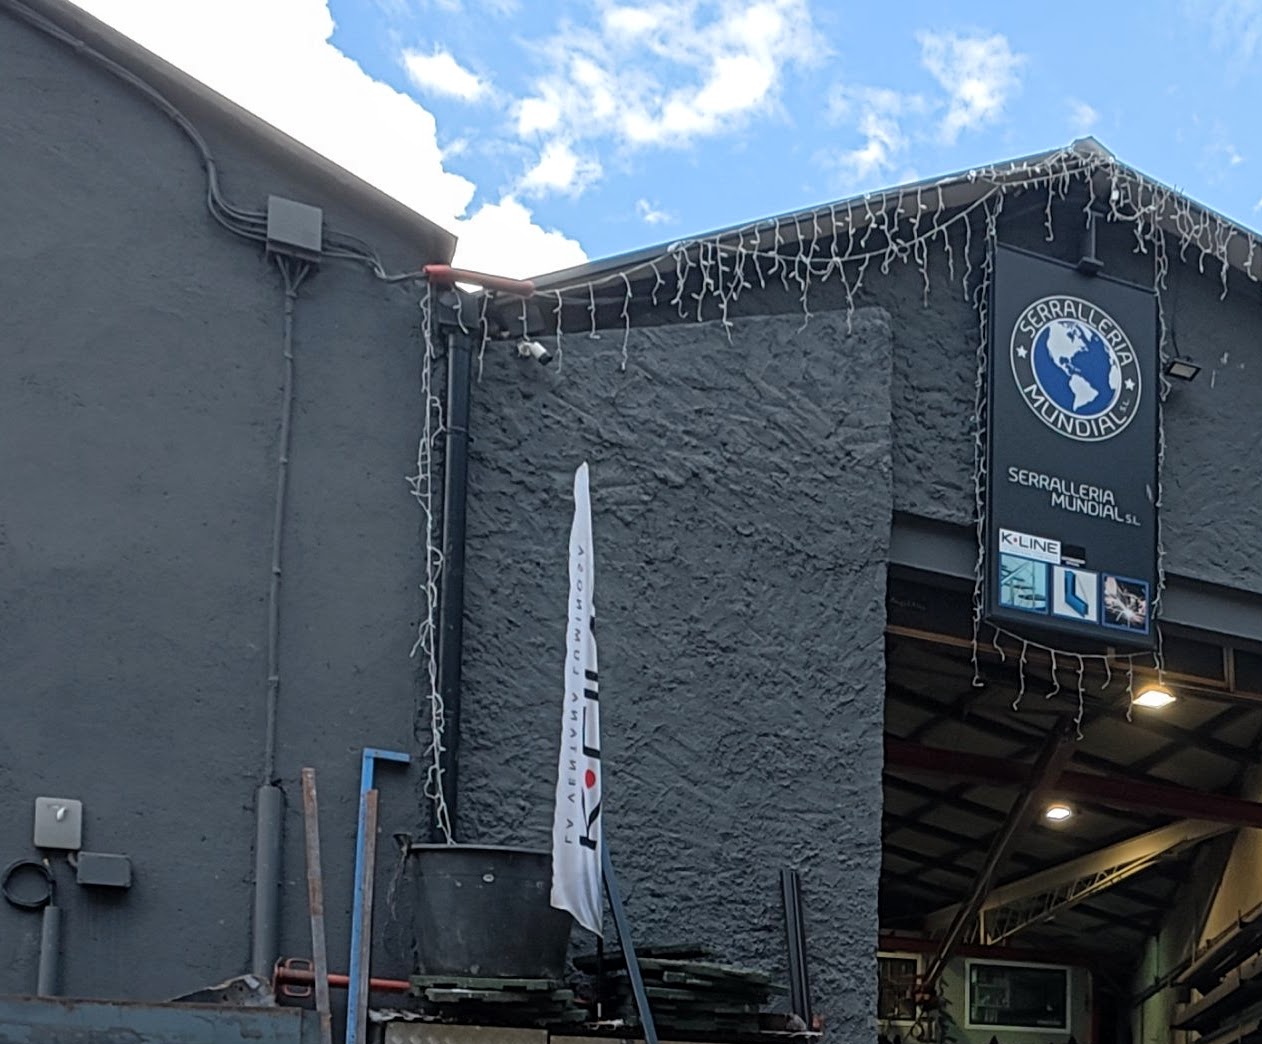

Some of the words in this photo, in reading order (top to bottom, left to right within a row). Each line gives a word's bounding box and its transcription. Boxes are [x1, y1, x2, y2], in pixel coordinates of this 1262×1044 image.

[1019, 299, 1134, 368] SERRALLERIA
[1023, 382, 1128, 437] MUNDIAL
[1007, 466, 1115, 505] SERRALLERIA
[1050, 492, 1125, 522] MUNDIAL
